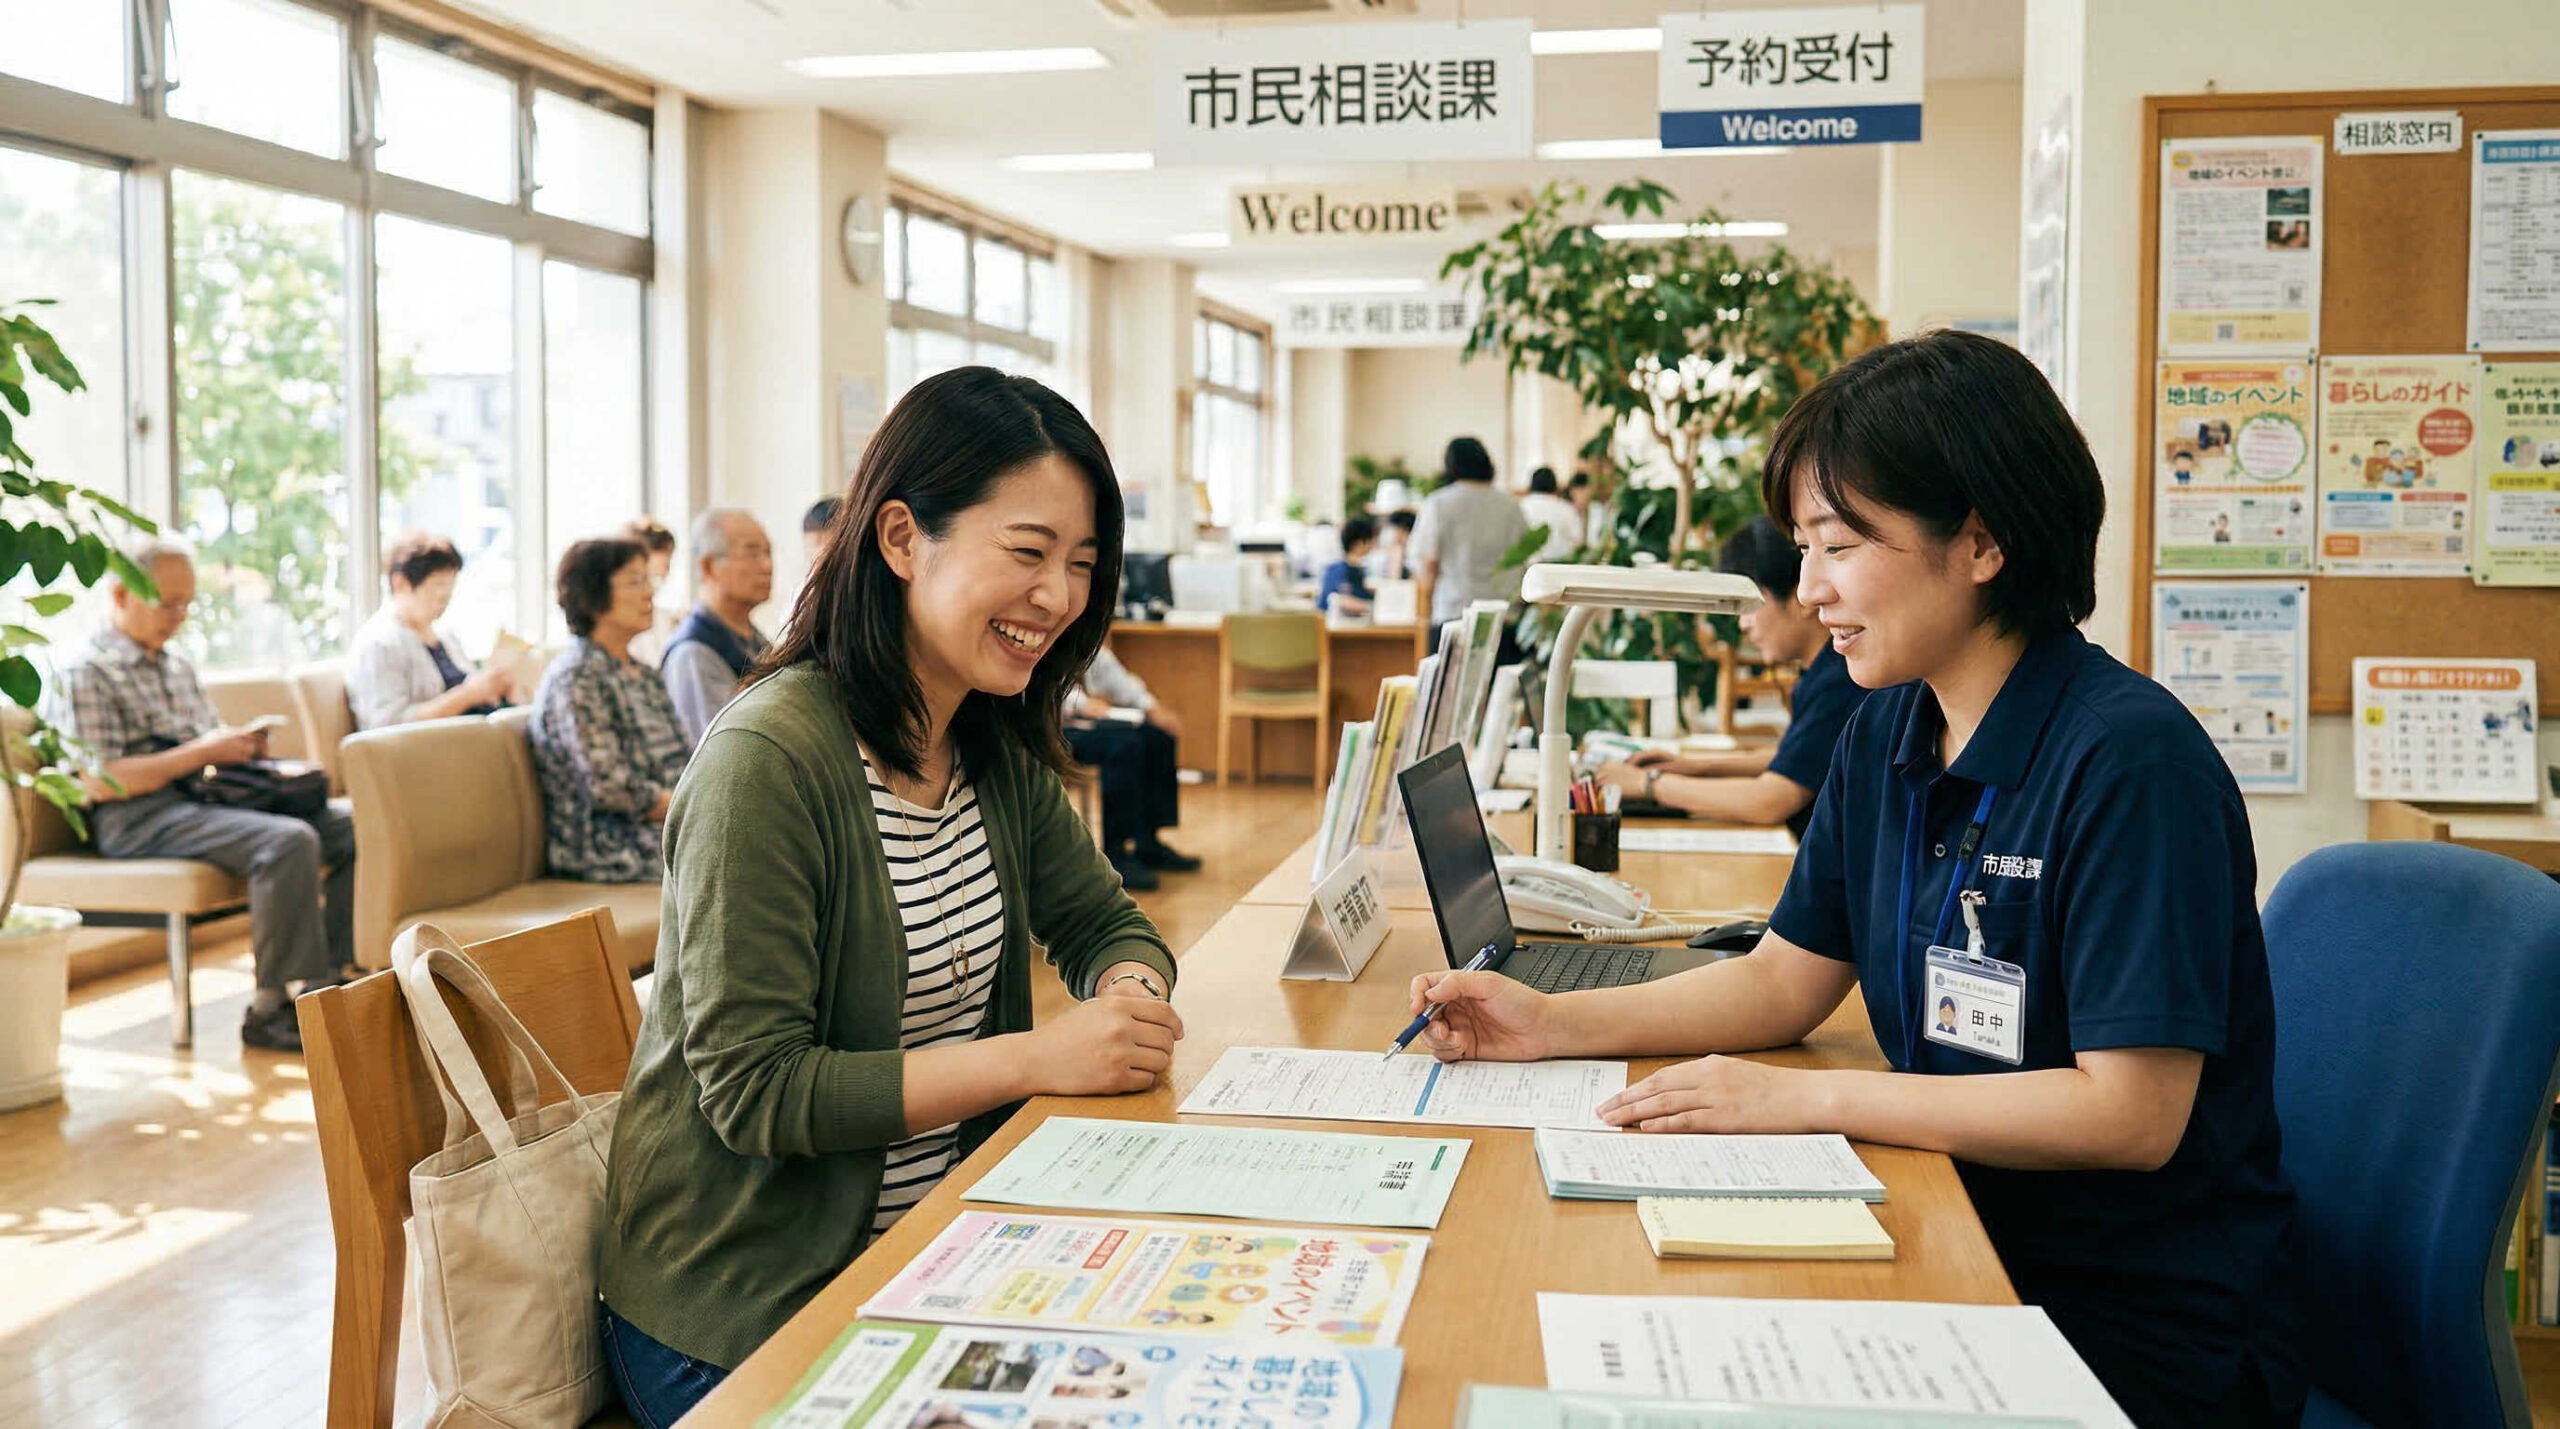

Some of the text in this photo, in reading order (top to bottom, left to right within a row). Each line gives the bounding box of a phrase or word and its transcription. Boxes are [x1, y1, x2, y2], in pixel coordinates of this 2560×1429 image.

[1687, 31, 1893, 87] 予約受付
[1185, 59, 1497, 129] 市民相談課
[1721, 114, 1859, 142] Welcome
[1238, 193, 1448, 233] Welcome
[1971, 1009, 2003, 1032] 田中
